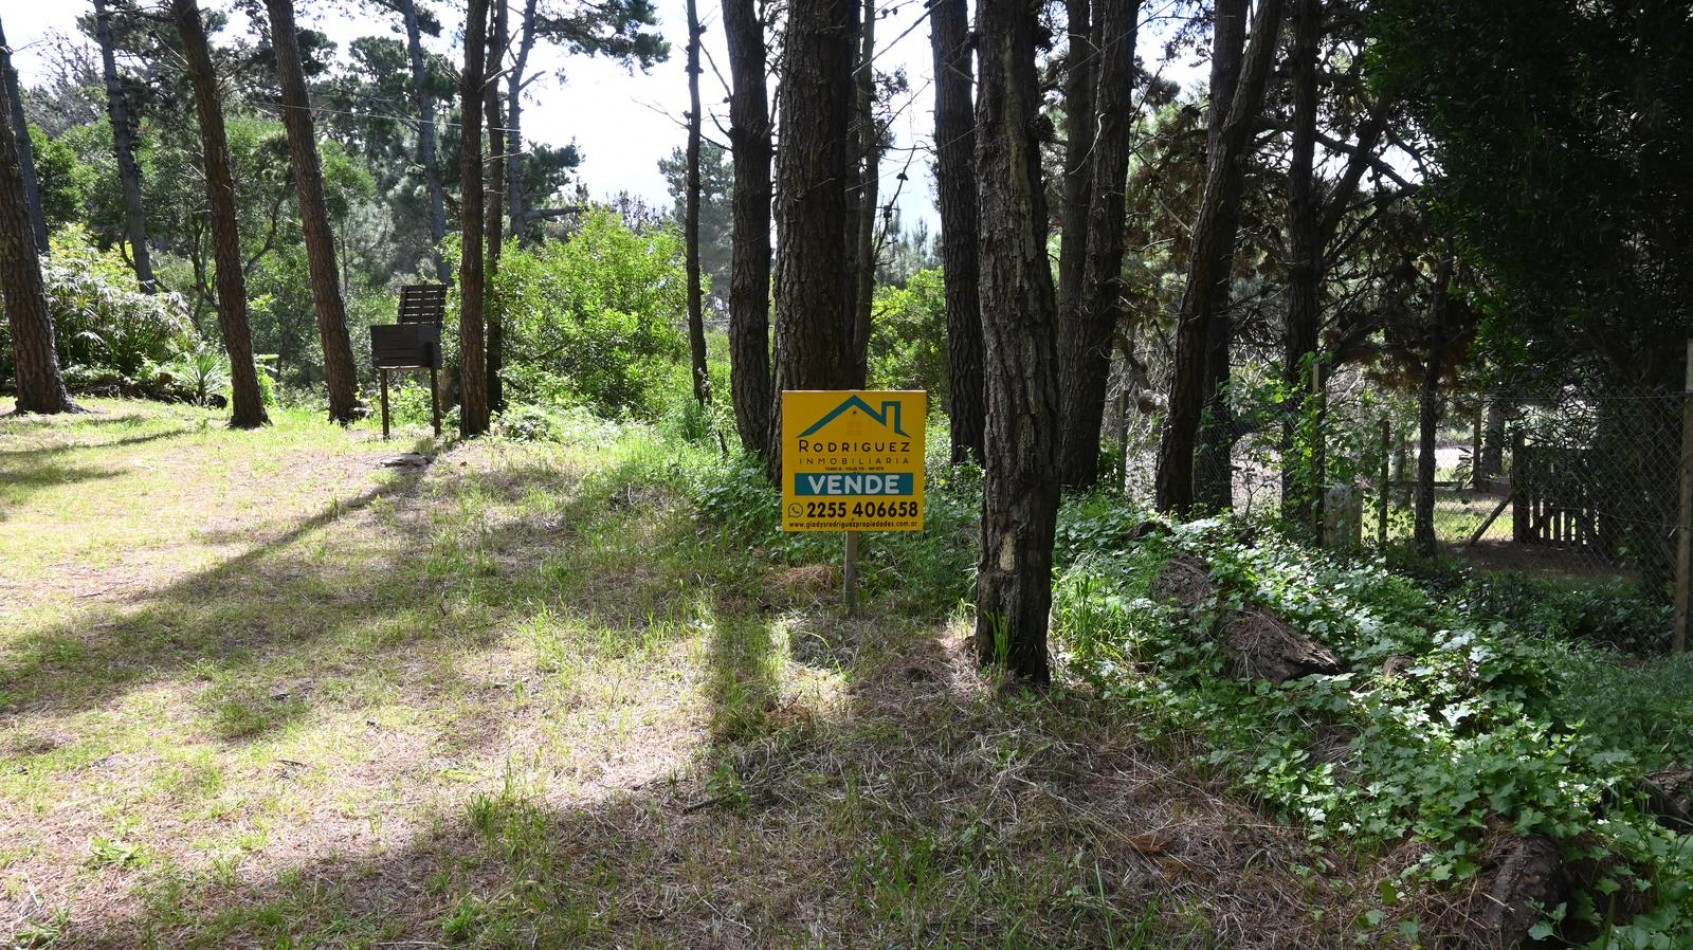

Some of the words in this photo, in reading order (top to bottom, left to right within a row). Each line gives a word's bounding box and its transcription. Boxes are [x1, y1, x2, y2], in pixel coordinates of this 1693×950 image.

[799, 440, 911, 453] RODRIGUEZ
[799, 457, 909, 465] INMOBILIARIA
[807, 475, 900, 495] VENDE
[806, 502, 847, 518] 2255
[852, 501, 918, 518] 406658
